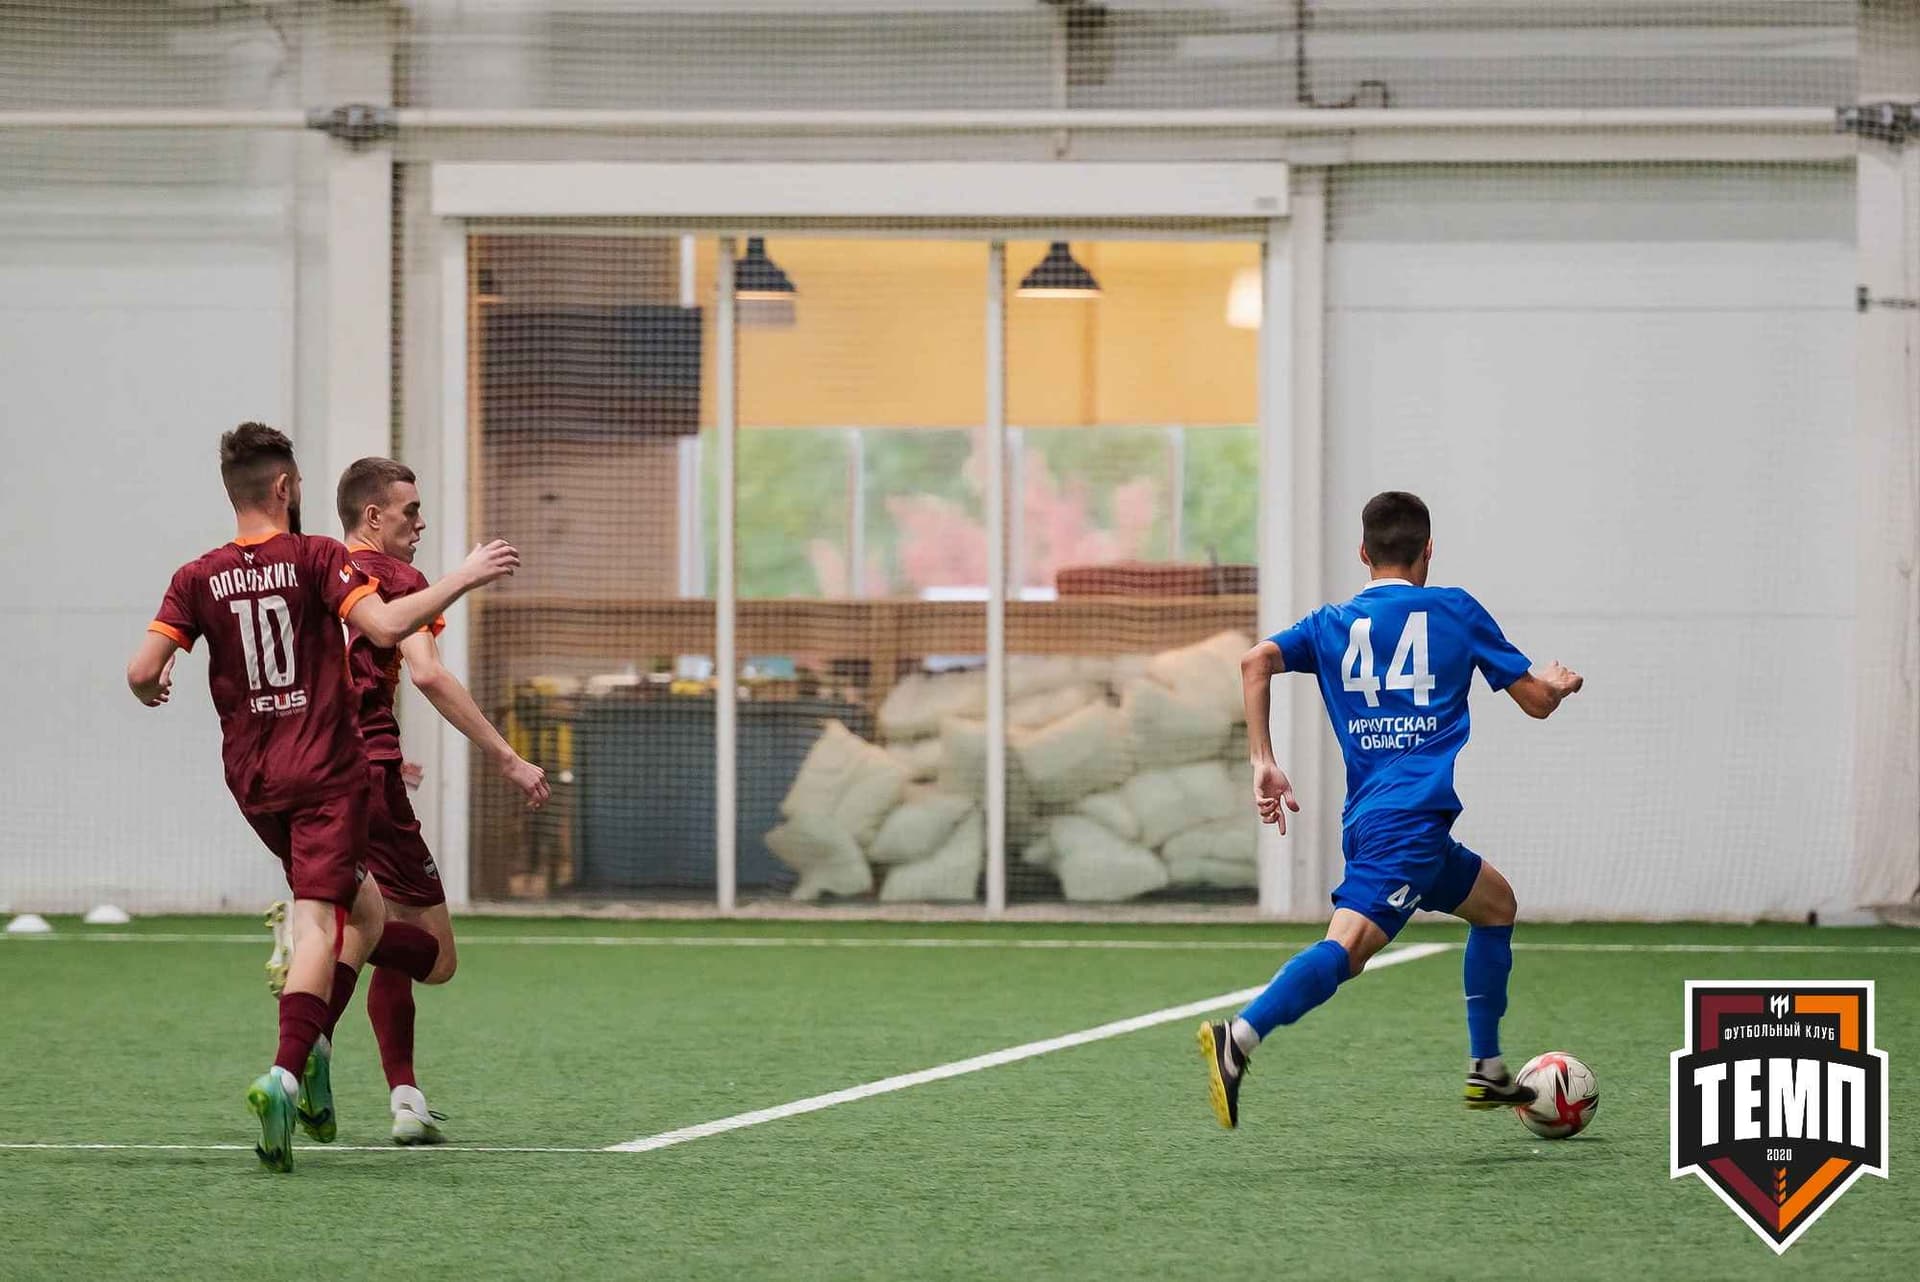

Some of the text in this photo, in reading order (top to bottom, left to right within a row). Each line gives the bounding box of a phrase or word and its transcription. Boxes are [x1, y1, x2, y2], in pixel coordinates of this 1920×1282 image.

[229, 594, 295, 691] 10
[1341, 610, 1435, 707] 44
[1348, 716, 1437, 734] ИРКУТСКАЯ
[1360, 733, 1426, 750] ОБЛАСТЬ
